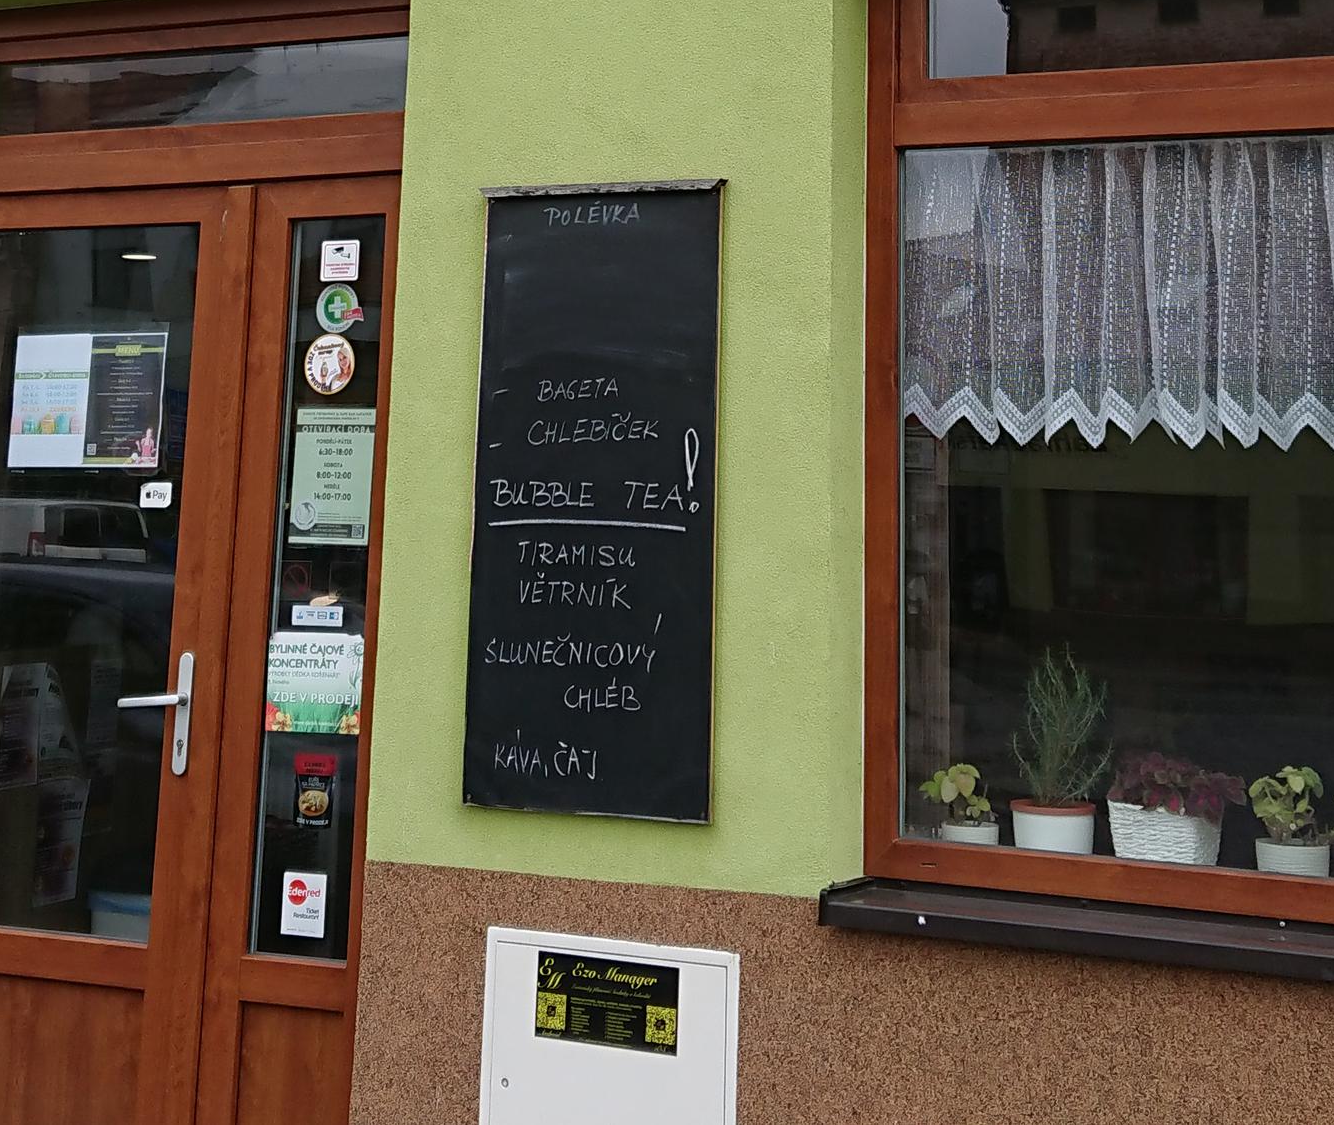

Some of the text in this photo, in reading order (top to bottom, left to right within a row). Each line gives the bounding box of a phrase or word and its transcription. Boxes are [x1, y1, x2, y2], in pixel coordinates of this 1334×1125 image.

[543, 200, 642, 228] POLÉVKA
[537, 378, 619, 402] BAGETA
[301, 425, 371, 434] OTEVÍRACÍ DOBA
[527, 412, 659, 446] CHLEBÍČEK
[152, 491, 167, 501] Pay
[313, 492, 351, 500] 14:00-17:00
[490, 479, 594, 507] BUBBLE
[518, 541, 635, 566] TIRAMISU
[519, 572, 631, 609] VĚTRNÍK
[269, 643, 344, 657] BYLINNÉ ČAJOVÉ
[484, 613, 662, 673] SLUNEČNICOVÝ
[268, 658, 338, 669] KONCENTRÁTY
[273, 691, 359, 707] ZDE V PRODEJI
[564, 677, 641, 712] CHLÉB
[287, 886, 320, 897] Edenred
[572, 963, 657, 989] Ezo Manager
